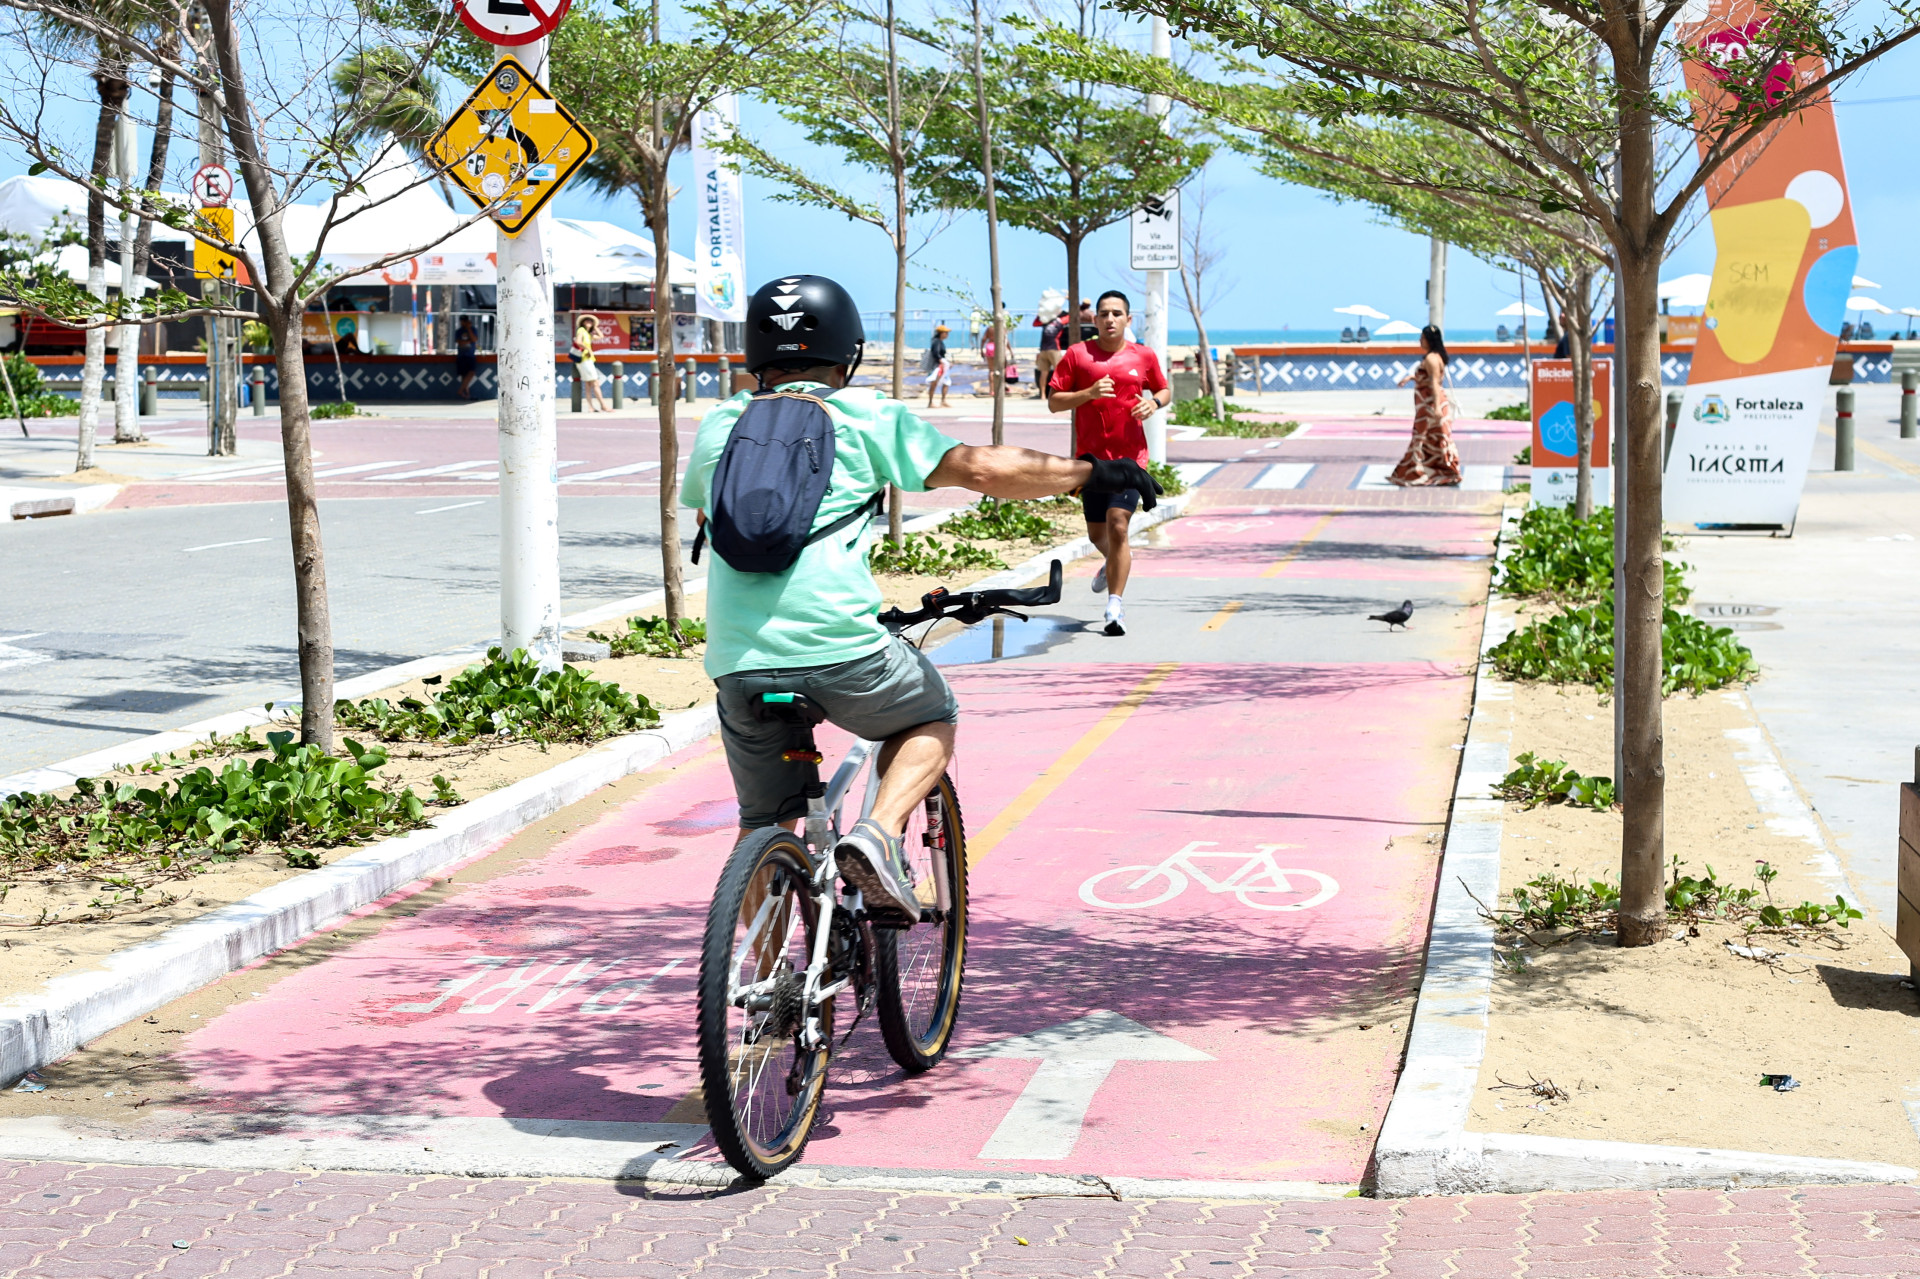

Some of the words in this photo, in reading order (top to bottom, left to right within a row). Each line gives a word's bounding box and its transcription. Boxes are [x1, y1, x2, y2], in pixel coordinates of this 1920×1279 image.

[206, 174, 221, 198] E
[708, 169, 722, 267] FORTALEZA
[723, 181, 733, 255] PREFEITURA
[1736, 397, 1804, 411] Fortaleza
[387, 954, 687, 1015] PARE
